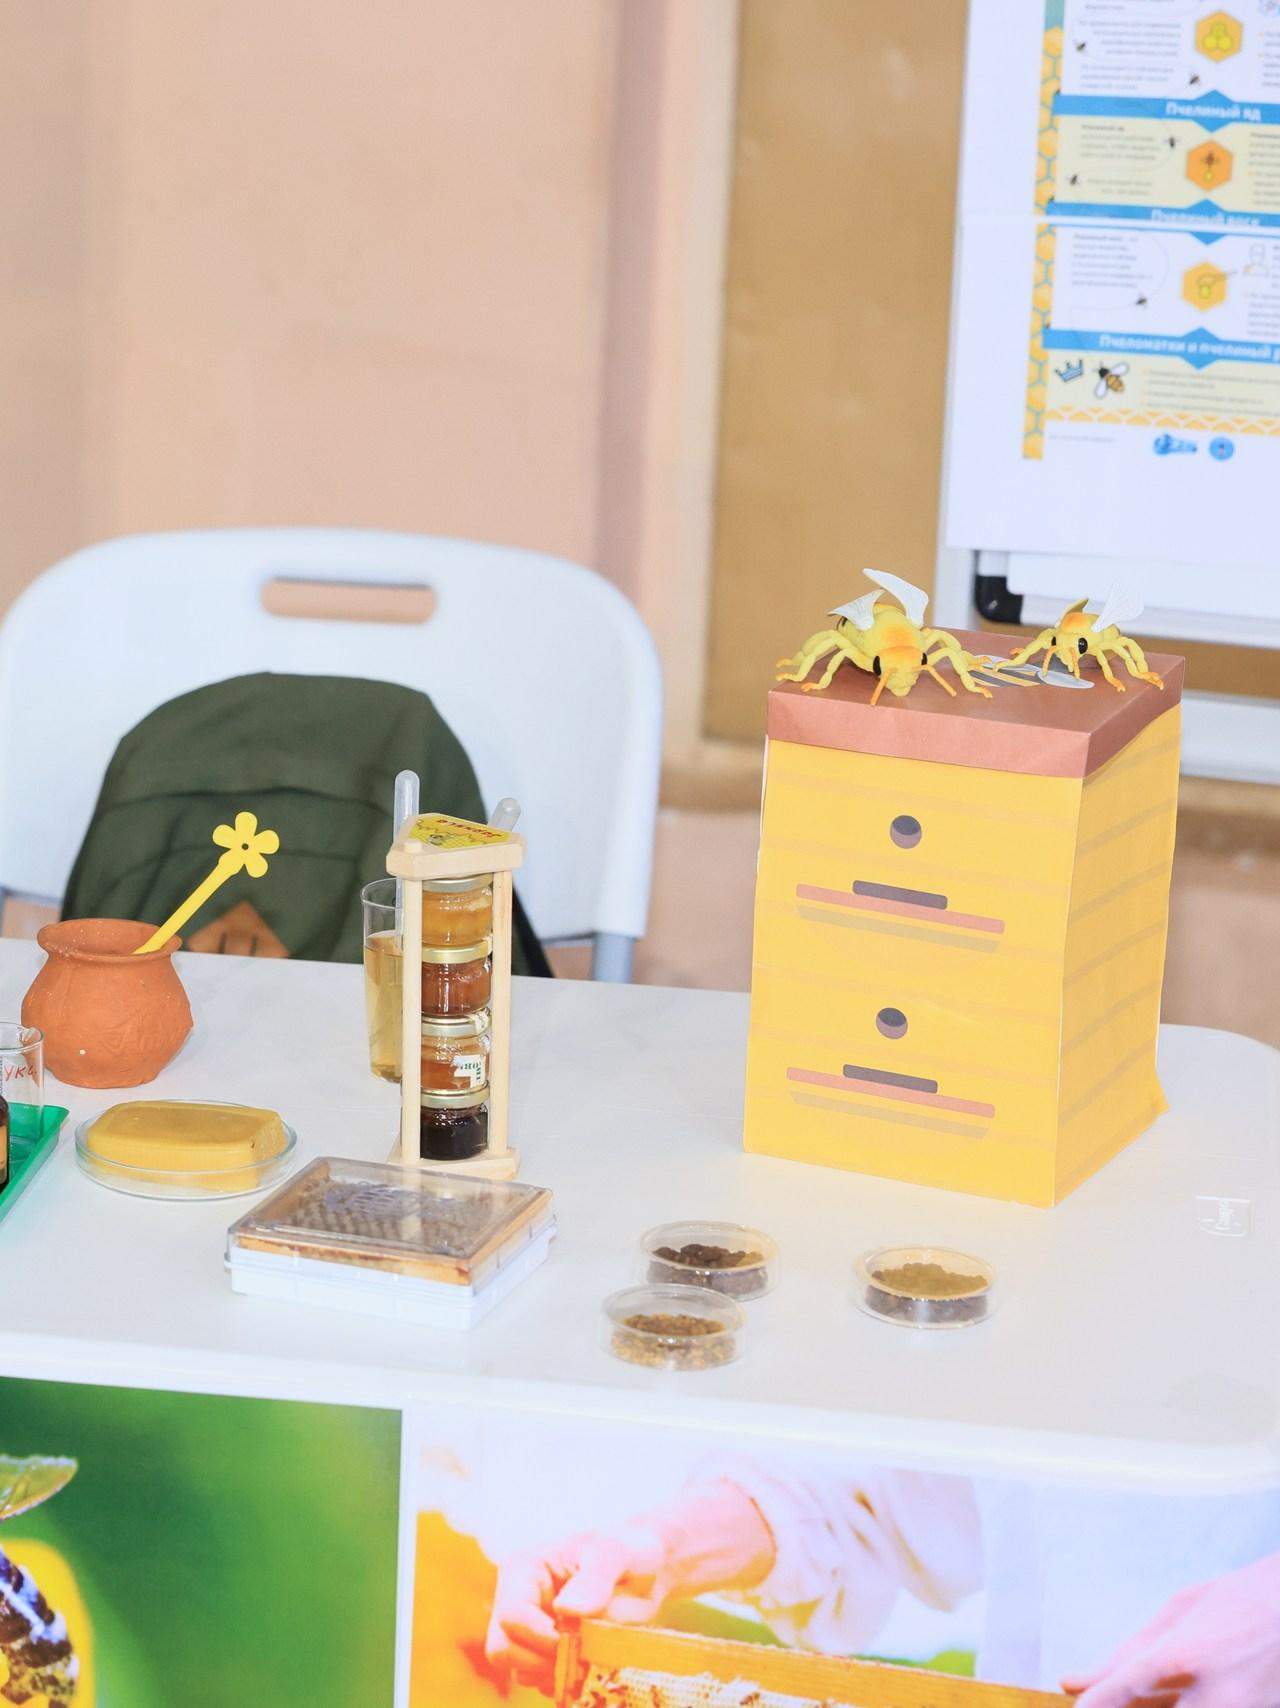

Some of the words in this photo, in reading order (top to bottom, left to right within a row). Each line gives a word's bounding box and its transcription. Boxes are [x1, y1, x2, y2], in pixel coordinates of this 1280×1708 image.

[1166, 100, 1240, 118] Пчелиный
[1244, 106, 1261, 121] яд
[1099, 335, 1185, 354] Пчеломатки
[1187, 342, 1197, 353] и
[1200, 341, 1271, 358] пчелиный
